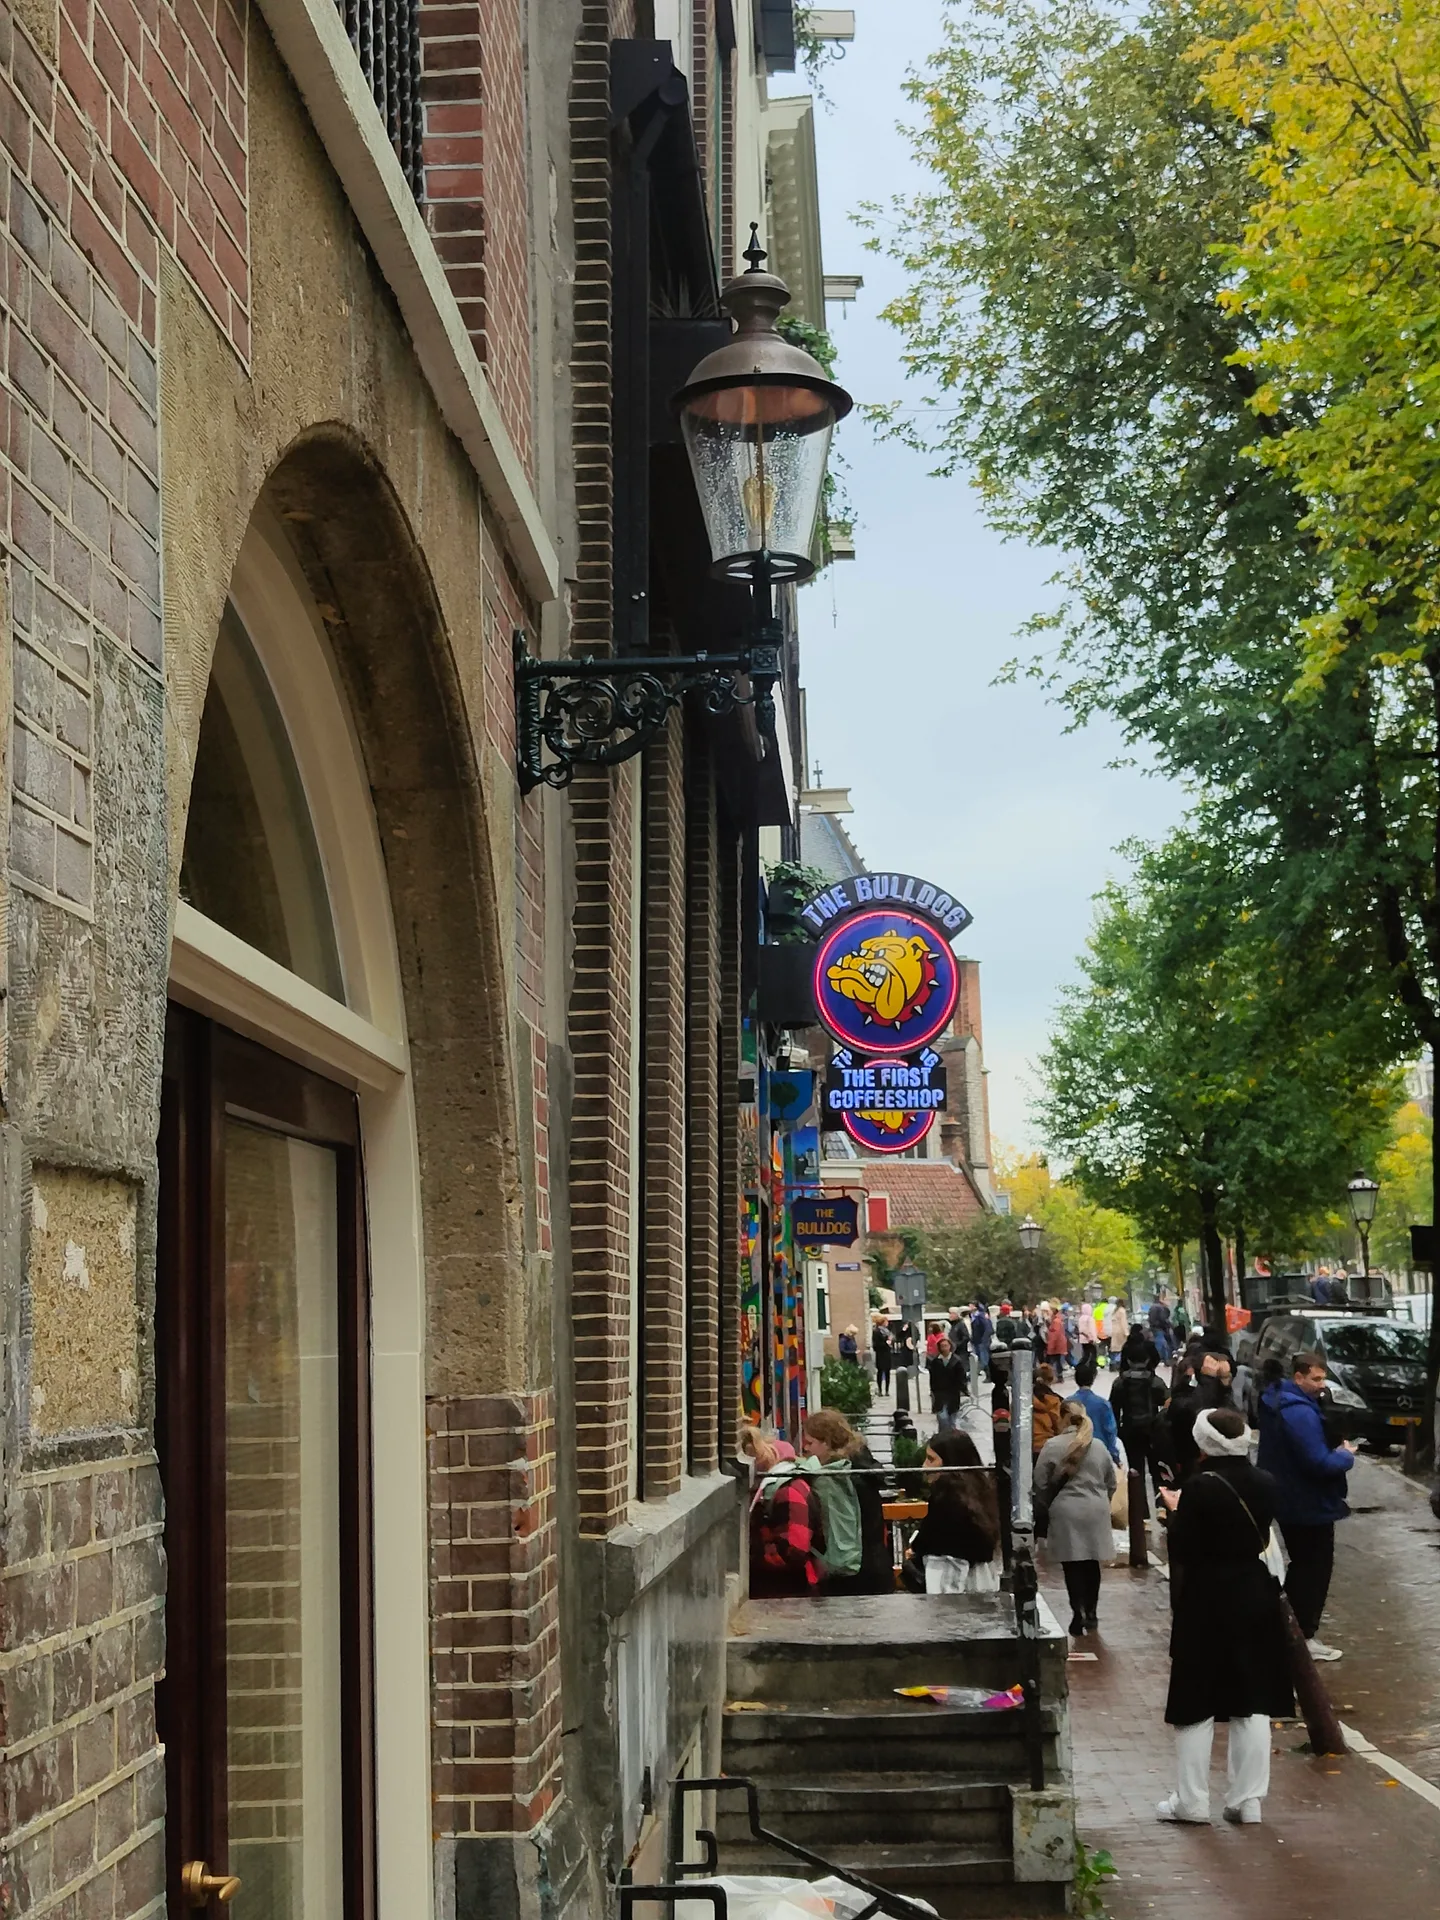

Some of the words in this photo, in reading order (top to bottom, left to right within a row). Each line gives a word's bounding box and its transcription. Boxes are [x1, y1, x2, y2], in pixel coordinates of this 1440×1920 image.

[801, 884, 852, 928] THE
[854, 875, 965, 929] BULLDOG
[841, 1069, 875, 1087] THE
[880, 1067, 932, 1087] FIRST
[829, 1088, 944, 1109] COFFEESHOP
[815, 1208, 835, 1218] THE
[796, 1221, 852, 1235] BULLDOG
